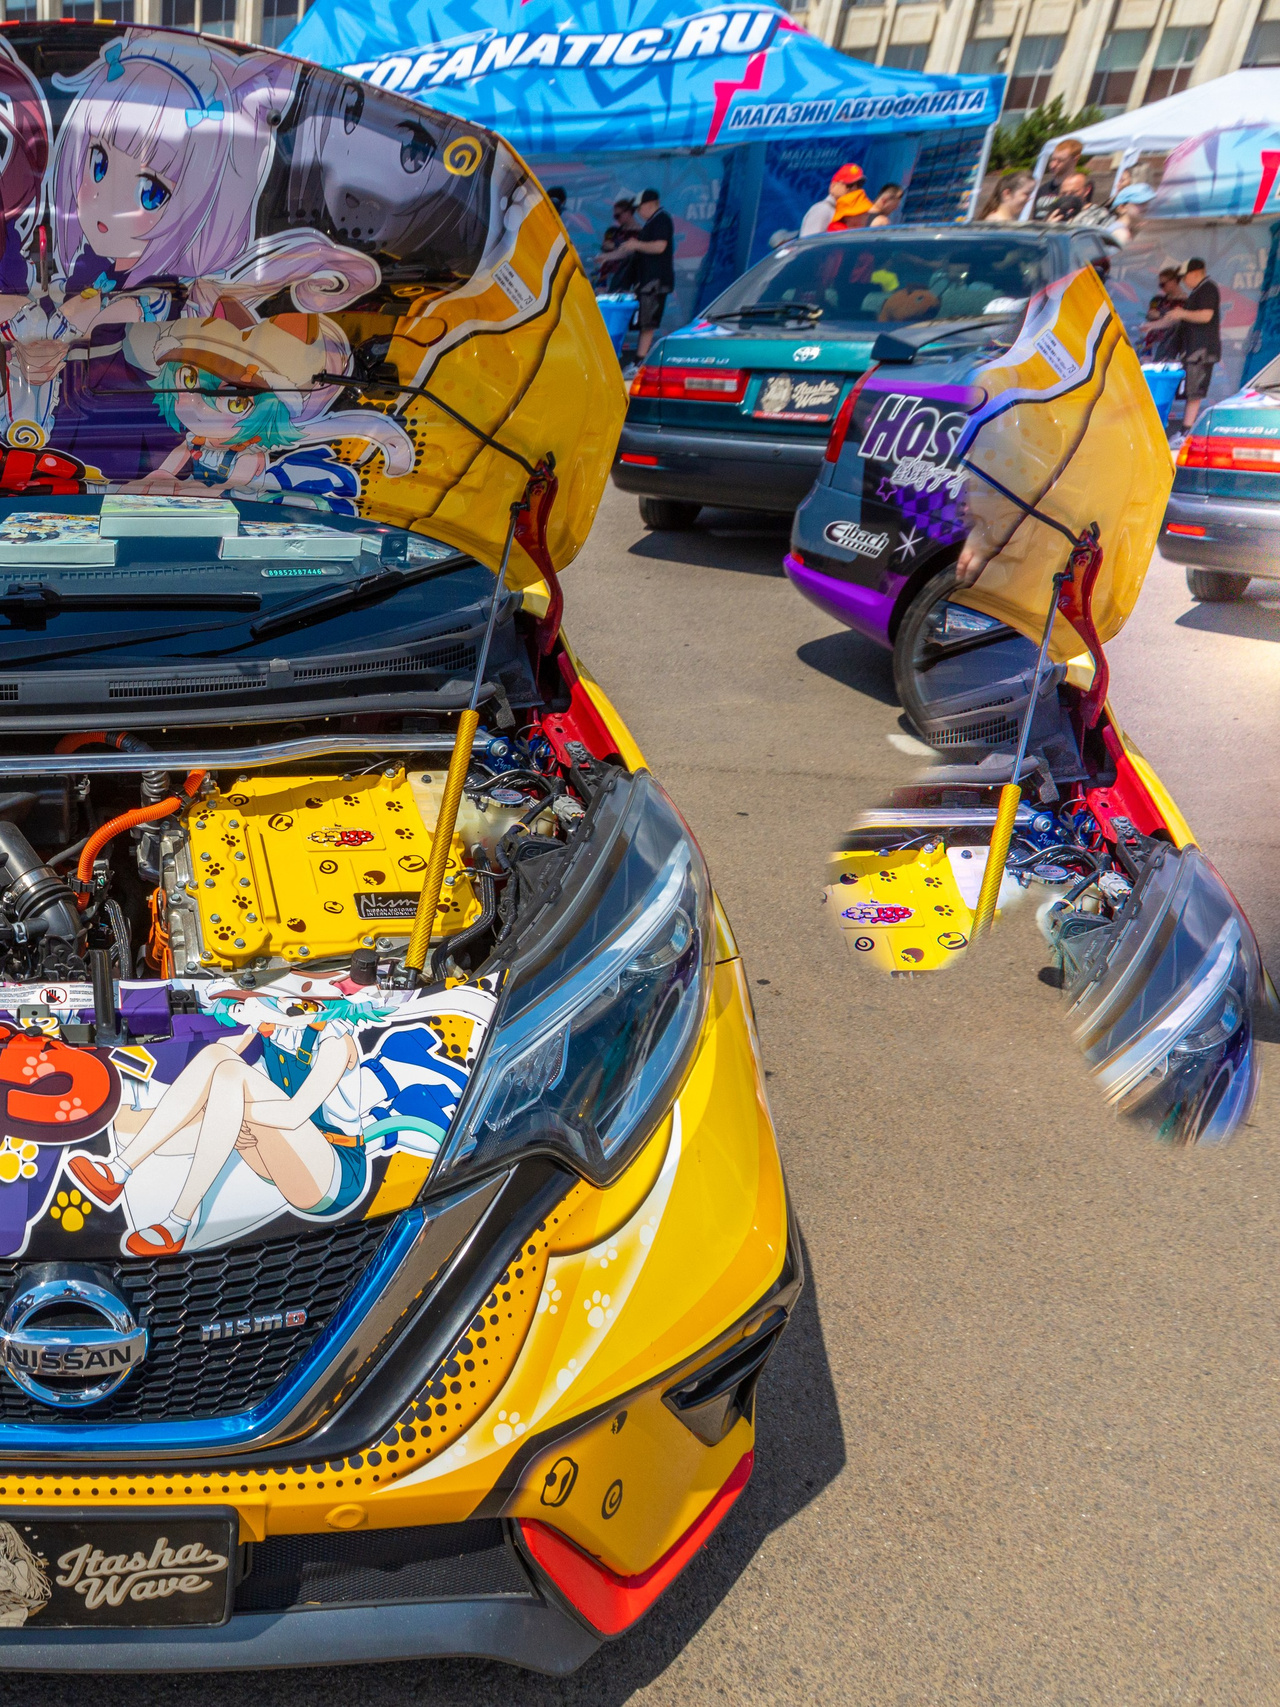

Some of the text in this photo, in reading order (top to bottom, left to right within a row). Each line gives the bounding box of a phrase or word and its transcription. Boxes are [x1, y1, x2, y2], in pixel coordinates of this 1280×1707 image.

[337, 12, 778, 91] TOFANATIC.RU
[730, 89, 988, 129] МАГАЗИН АВТОФАНАТА
[824, 521, 890, 557] Eibach
[360, 893, 420, 917] Nism
[200, 1307, 308, 1343] nismo
[6, 1346, 132, 1370] NISSAN
[56, 1537, 228, 1587] Itasha
[75, 1569, 213, 1610] Wave
